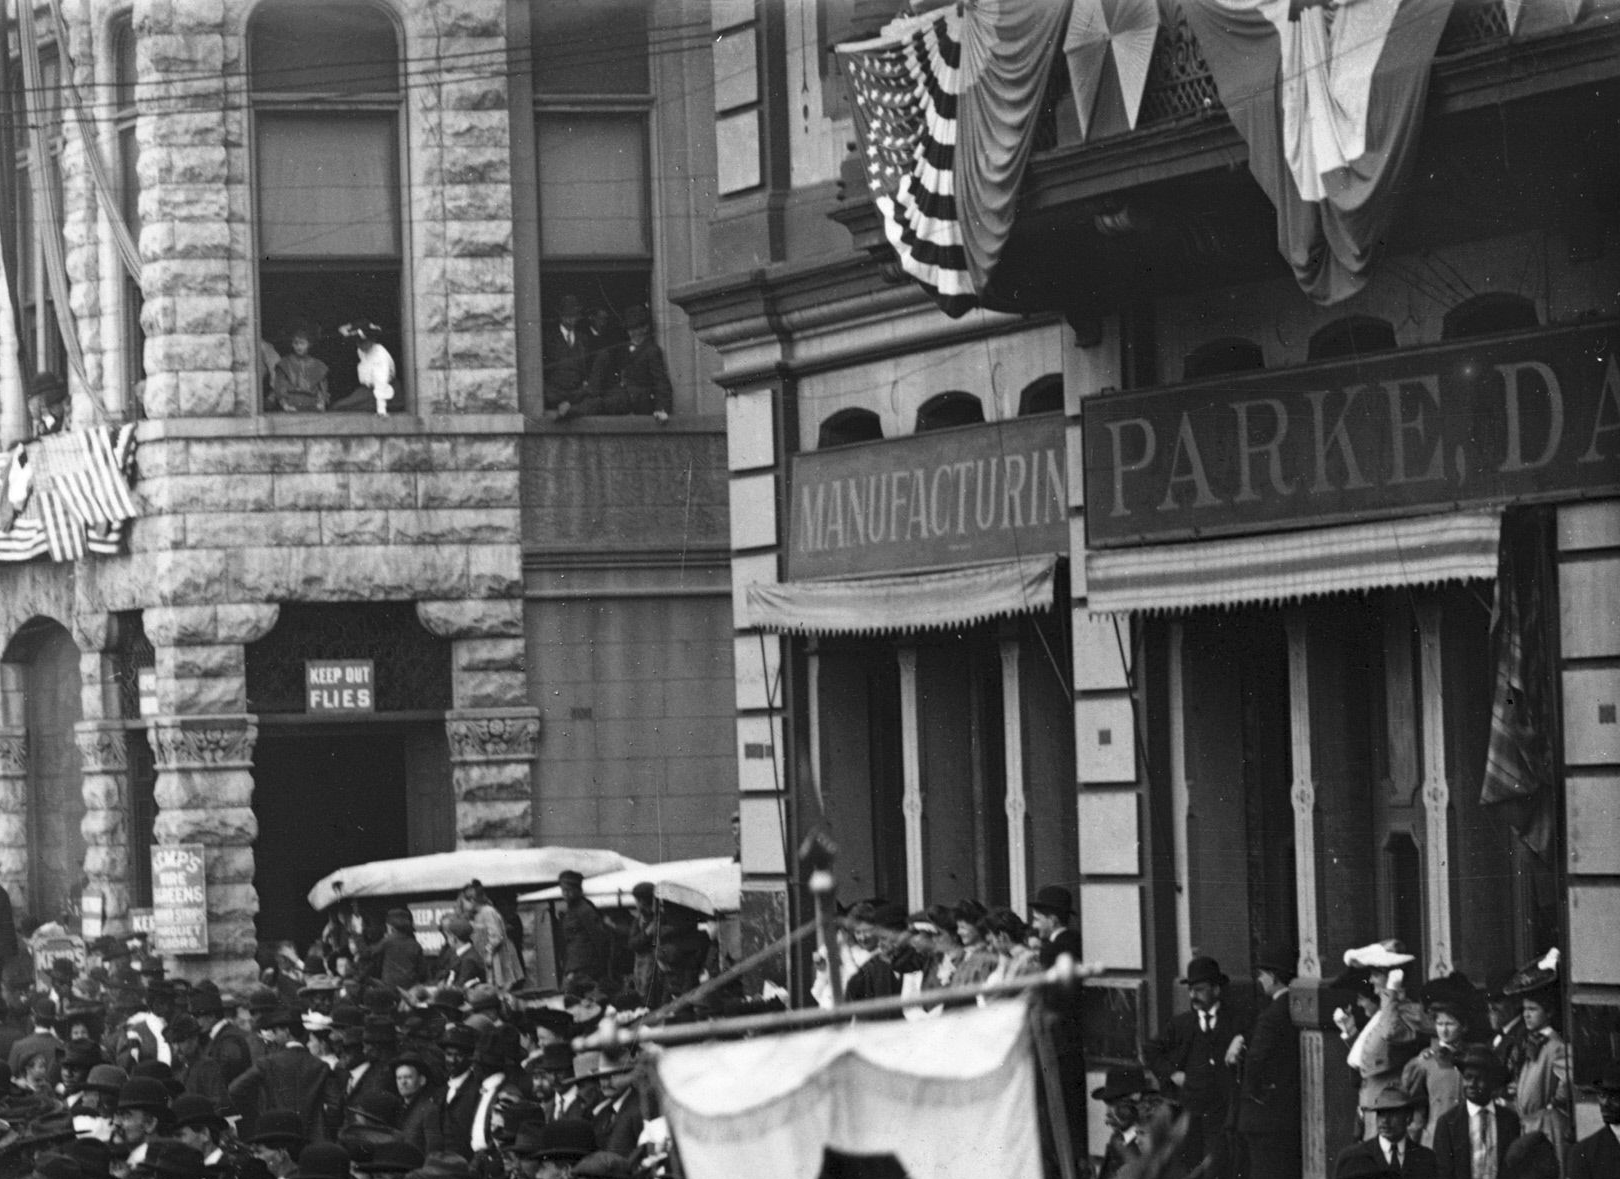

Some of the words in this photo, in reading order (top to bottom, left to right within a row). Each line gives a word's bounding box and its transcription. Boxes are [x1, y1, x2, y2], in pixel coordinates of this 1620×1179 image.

[1104, 374, 1466, 518] PARKE,
[1494, 352, 1620, 474] DA
[798, 449, 1068, 552] MANUFACTURIN
[309, 666, 342, 684] KEEP
[345, 665, 370, 683] OUT
[310, 689, 371, 708] FLIES
